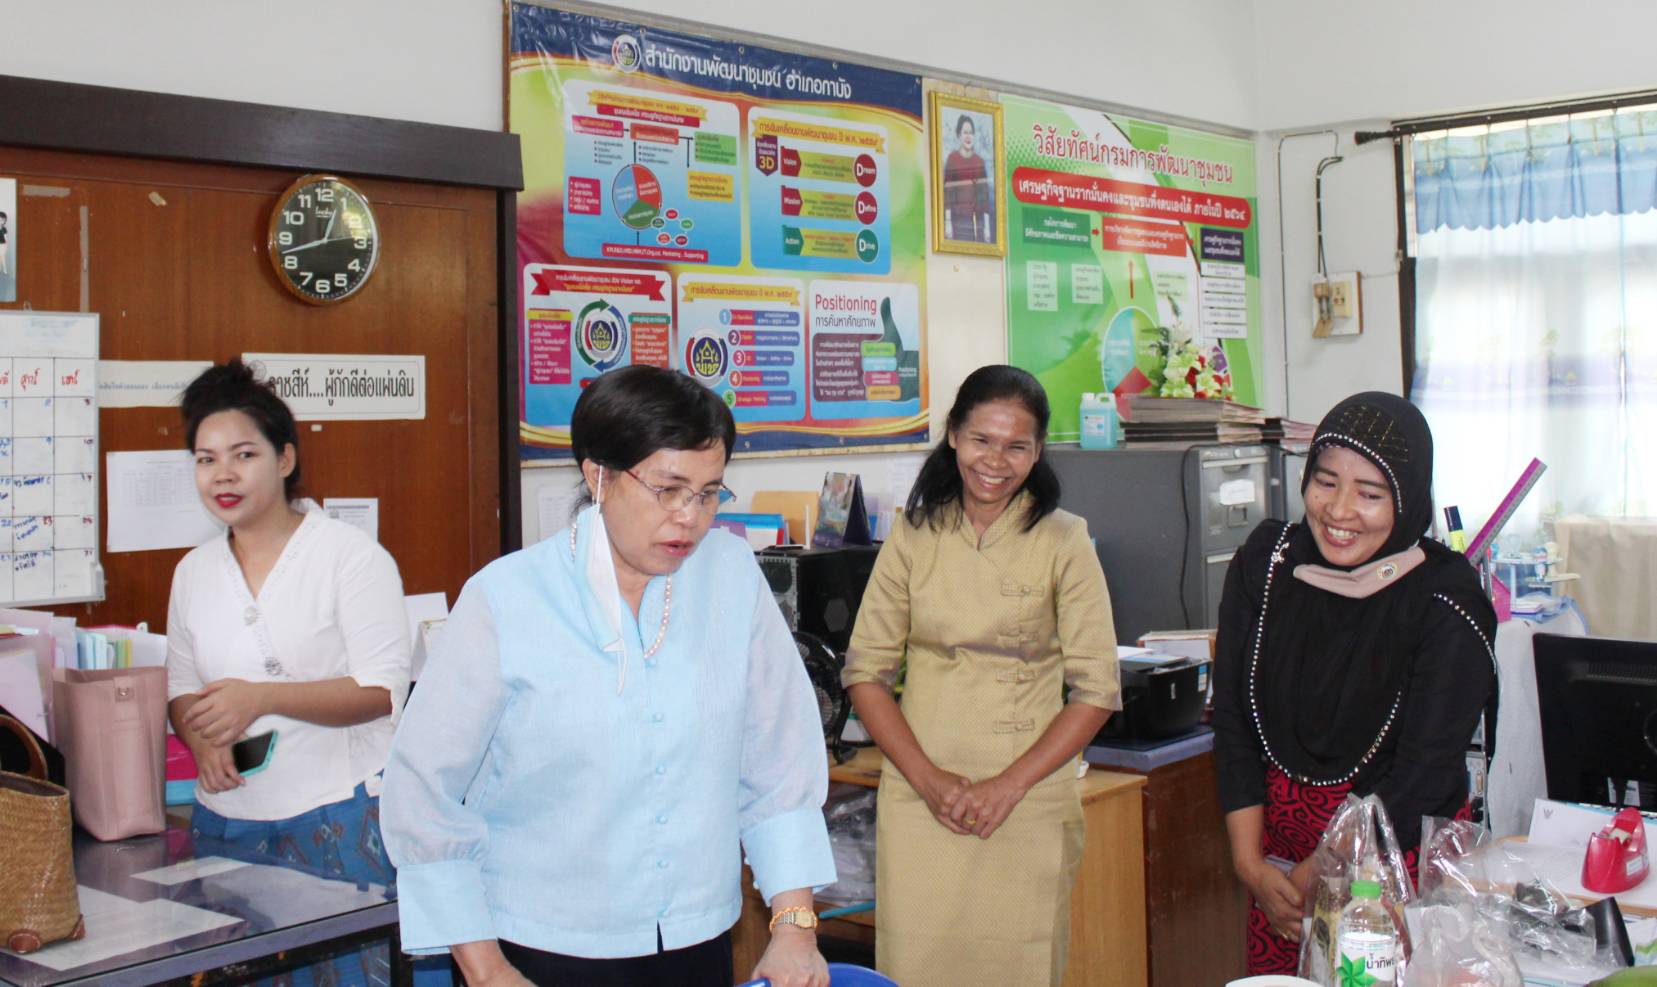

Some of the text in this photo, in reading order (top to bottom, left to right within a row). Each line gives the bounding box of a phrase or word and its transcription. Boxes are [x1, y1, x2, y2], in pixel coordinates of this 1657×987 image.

[645, 43, 852, 99] สำนักงานพัฒนาชุมชน อำเภอกาบัง
[760, 155, 775, 170] 3D
[1033, 124, 1233, 189] วิสัยทัศน์กรมการพัฒนาชุมชน
[297, 194, 312, 208] 11
[314, 187, 335, 202] 12
[340, 197, 347, 210] 1
[283, 210, 305, 226] 10
[278, 231, 293, 246] 9
[353, 236, 368, 250] 3
[284, 255, 298, 270] 8
[347, 258, 361, 273] 4
[299, 271, 313, 287] 7
[315, 279, 331, 294] 6
[334, 273, 348, 287] 5
[815, 294, 877, 315] Positioning
[815, 315, 876, 328] การค้นหาศักยภาพ
[731, 332, 737, 343] 2
[736, 352, 743, 364] 3
[731, 373, 738, 385] 4
